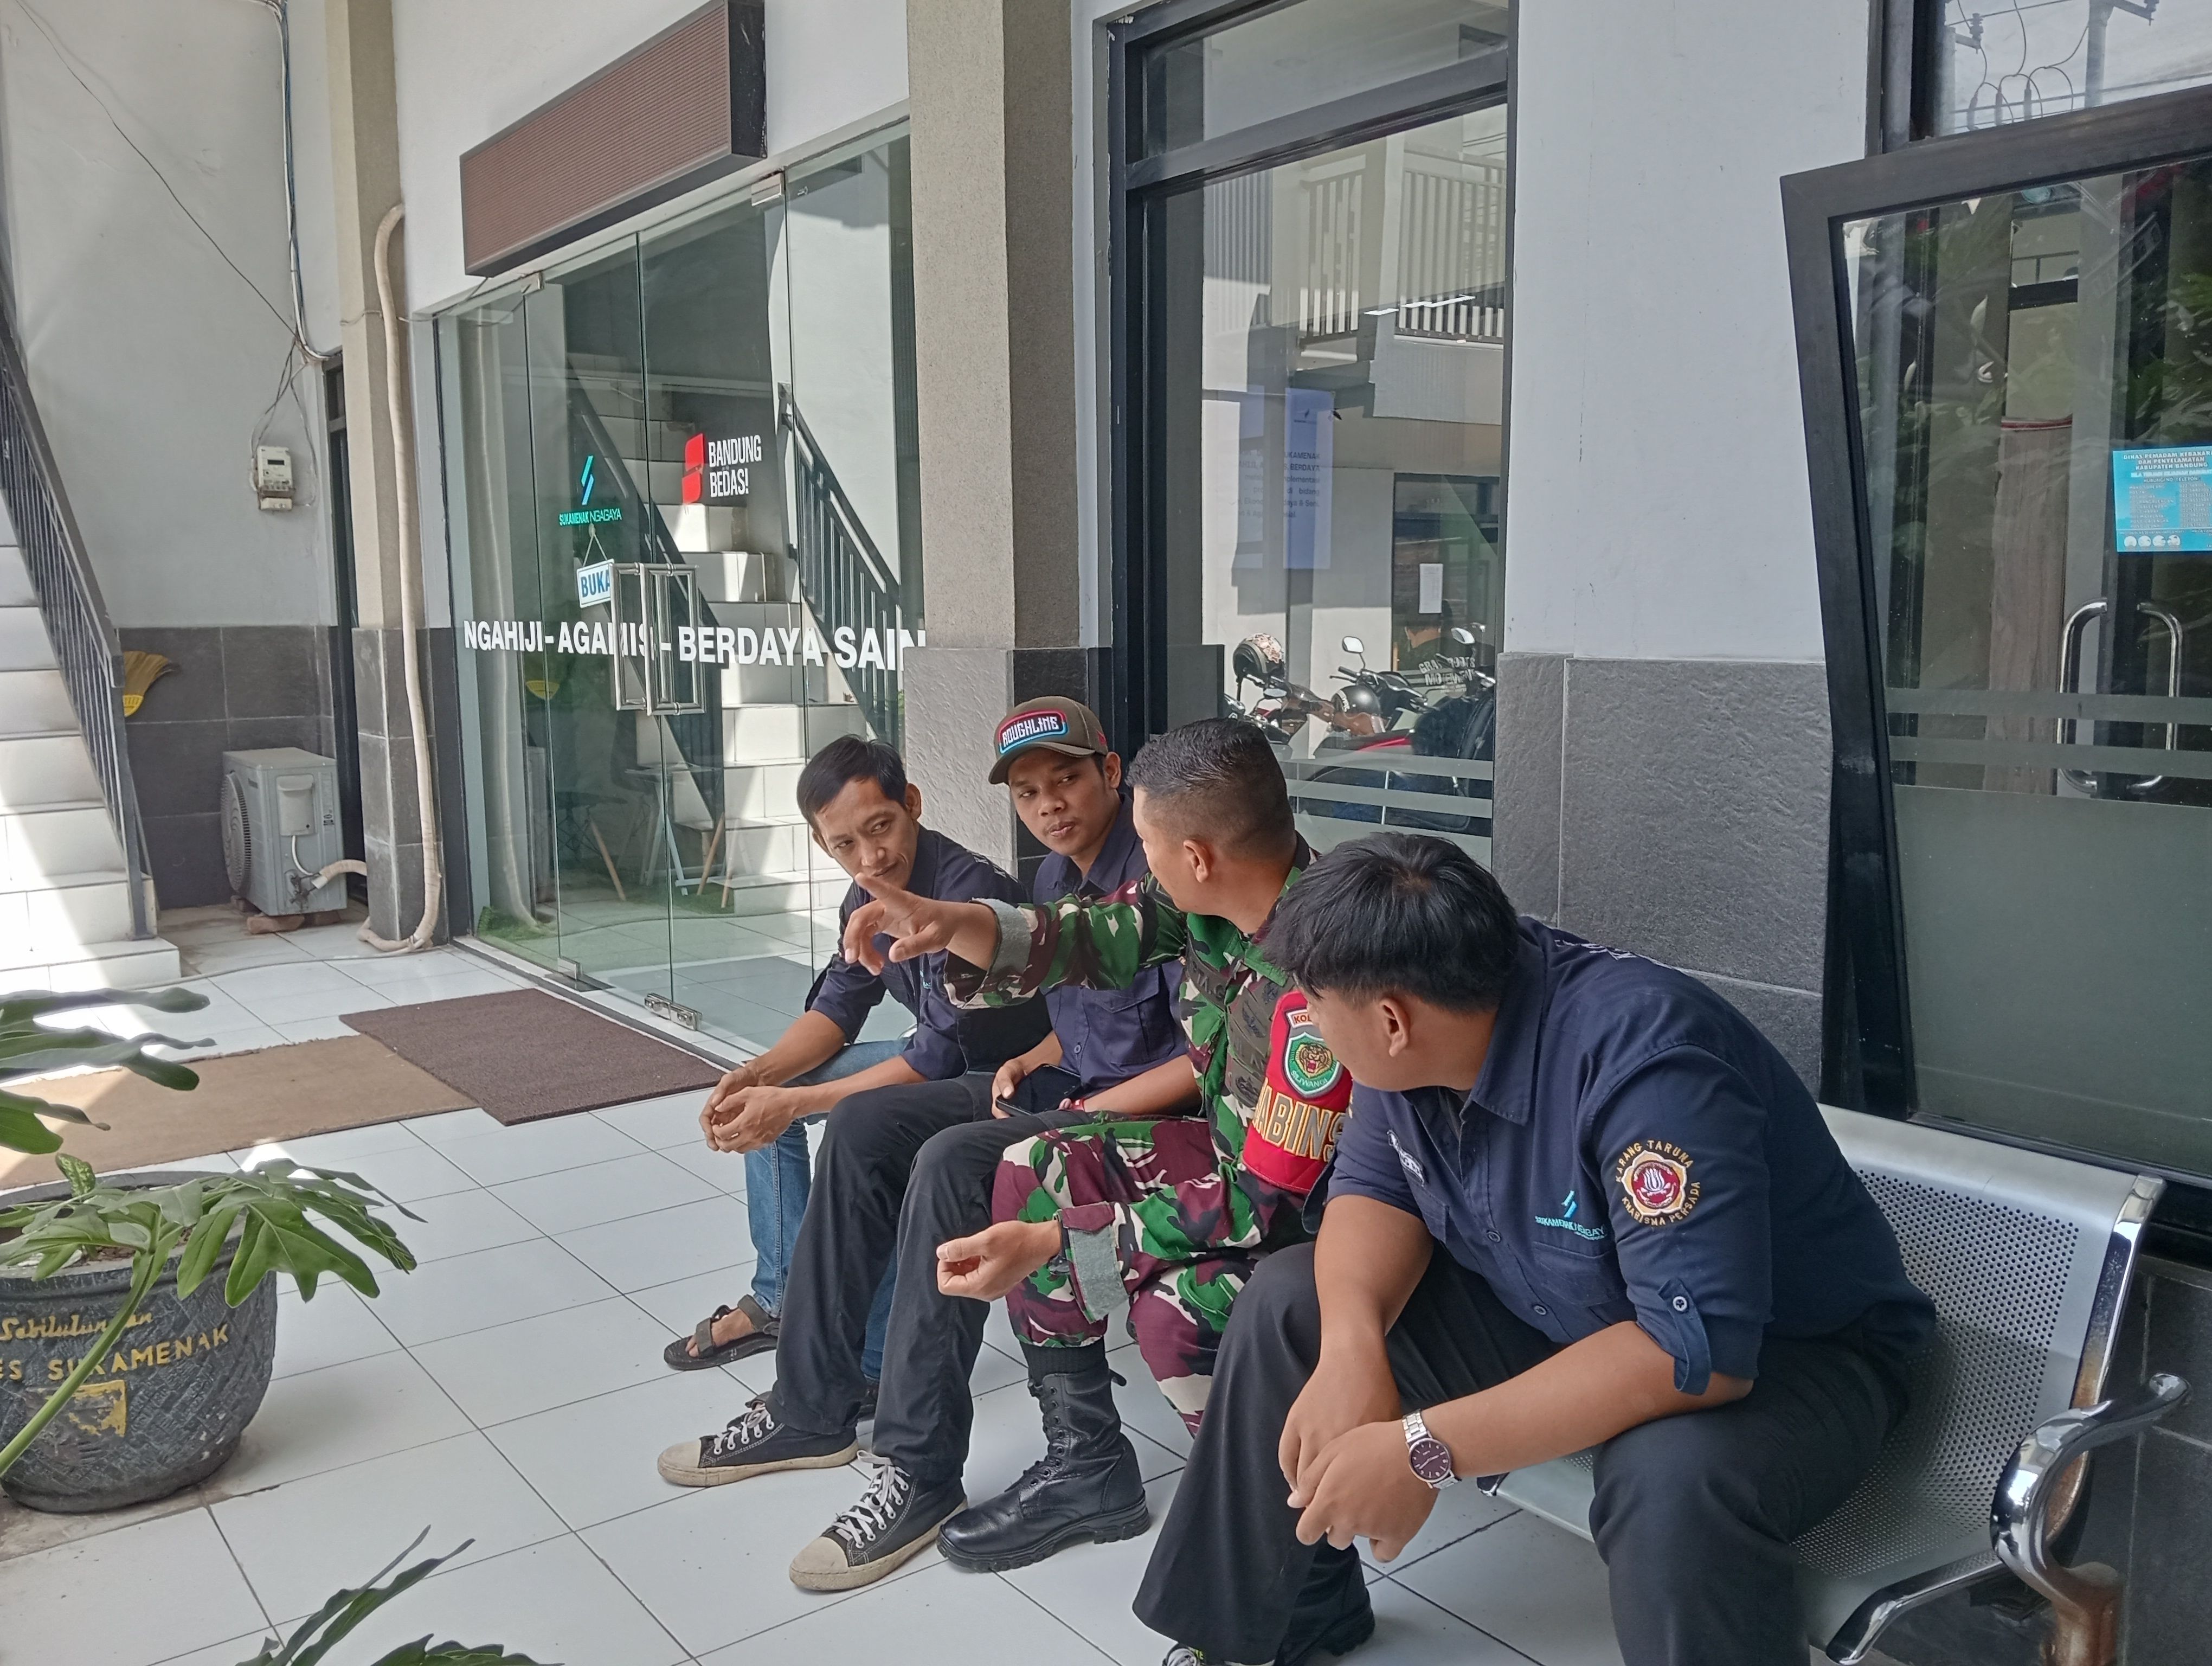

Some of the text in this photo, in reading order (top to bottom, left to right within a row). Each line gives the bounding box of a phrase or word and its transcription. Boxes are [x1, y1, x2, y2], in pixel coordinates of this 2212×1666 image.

[708, 435, 762, 467] BANDUNG
[710, 468, 749, 497] BEDAS!
[559, 508, 622, 526] SUKAMENAK NGAGAYA
[678, 626, 824, 667] BERDAYA
[1616, 1143, 1643, 1183] KARANG
[1648, 1140, 1694, 1168] TARUNA
[47, 1323, 230, 1381] SUAMENAK
